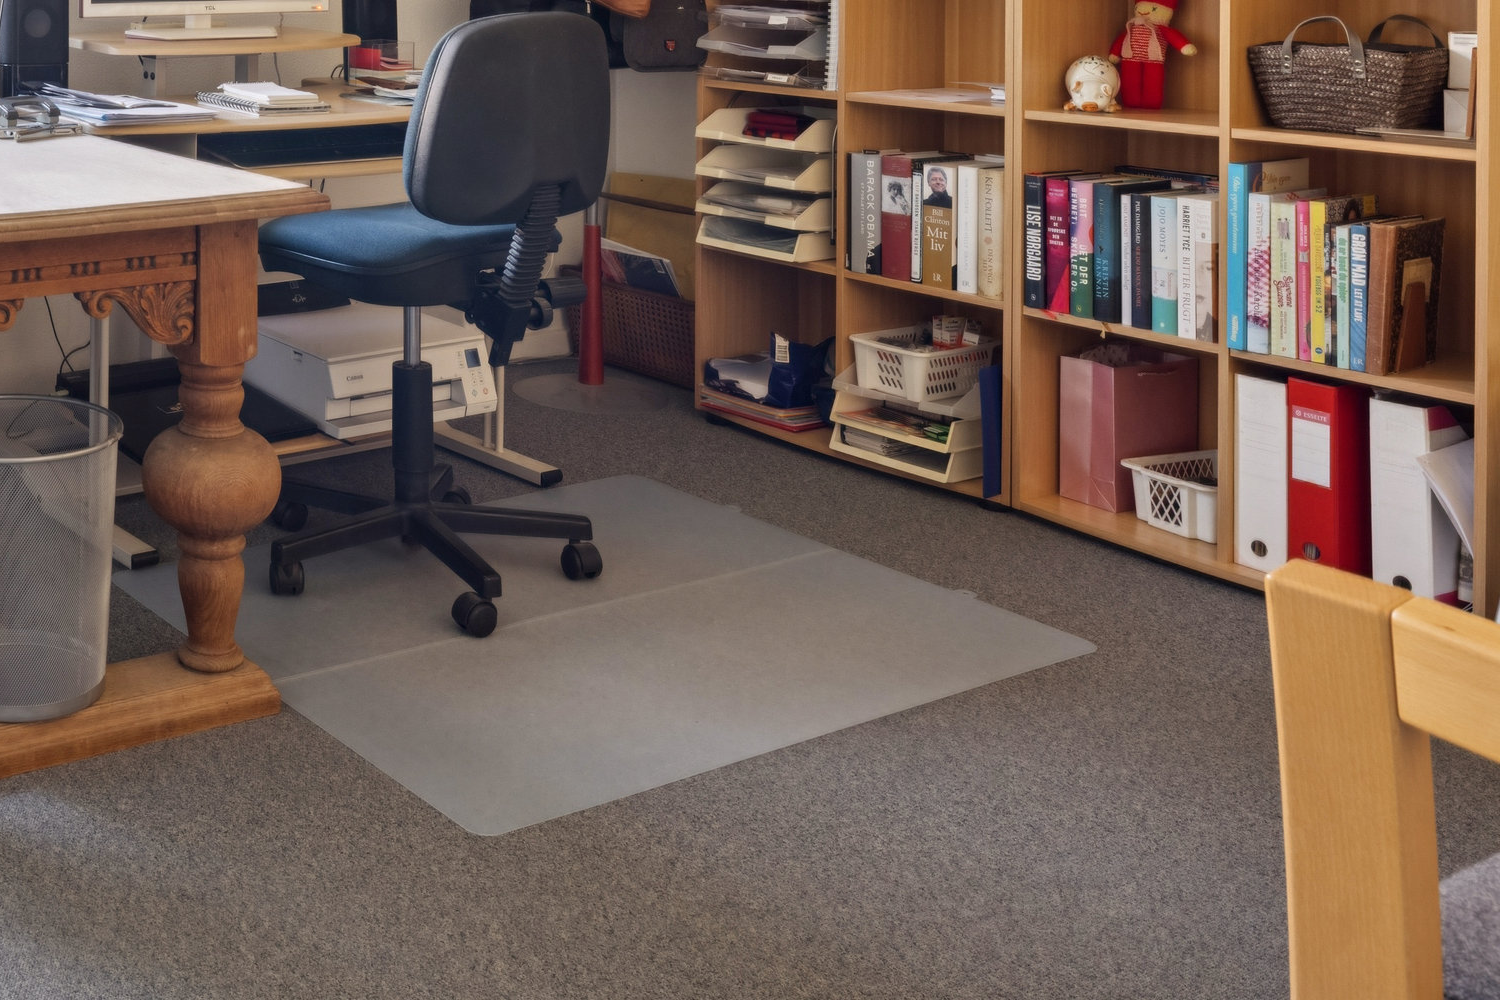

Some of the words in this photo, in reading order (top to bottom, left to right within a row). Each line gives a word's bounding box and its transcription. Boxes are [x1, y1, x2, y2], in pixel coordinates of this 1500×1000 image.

[866, 160, 875, 210] BARACK
[985, 177, 993, 196] KEN
[931, 208, 944, 217] Bill
[984, 197, 993, 234] FOLLETT
[1026, 204, 1041, 227] LISE
[1079, 197, 1087, 218] BRIT
[1157, 205, 1166, 224] JOJO
[924, 216, 950, 226] Clinton
[1182, 205, 1190, 234] HARRIET
[866, 214, 875, 258] OBAMA
[926, 226, 948, 240] Mit
[930, 239, 944, 251] liv
[1079, 244, 1088, 262] DET
[1182, 235, 1190, 252] TYCE
[1339, 247, 1346, 255] er
[1351, 233, 1367, 262] GRØN
[1026, 227, 1041, 281] NØRGAARD
[1070, 236, 1078, 276] SKILLER
[1079, 265, 1088, 285] DER
[1101, 259, 1109, 298] KRISTIN
[1182, 256, 1190, 289] BITTER
[1338, 273, 1347, 281] du
[1352, 264, 1367, 286] MAD
[1315, 275, 1323, 296] KOGEBOG
[1354, 288, 1363, 299] LET
[1182, 292, 1190, 322] FRUGT
[1254, 291, 1264, 325] Karoline
[1354, 300, 1363, 308] AT
[1354, 308, 1363, 323] LAVE
[1303, 411, 1327, 422] ESSELTE
